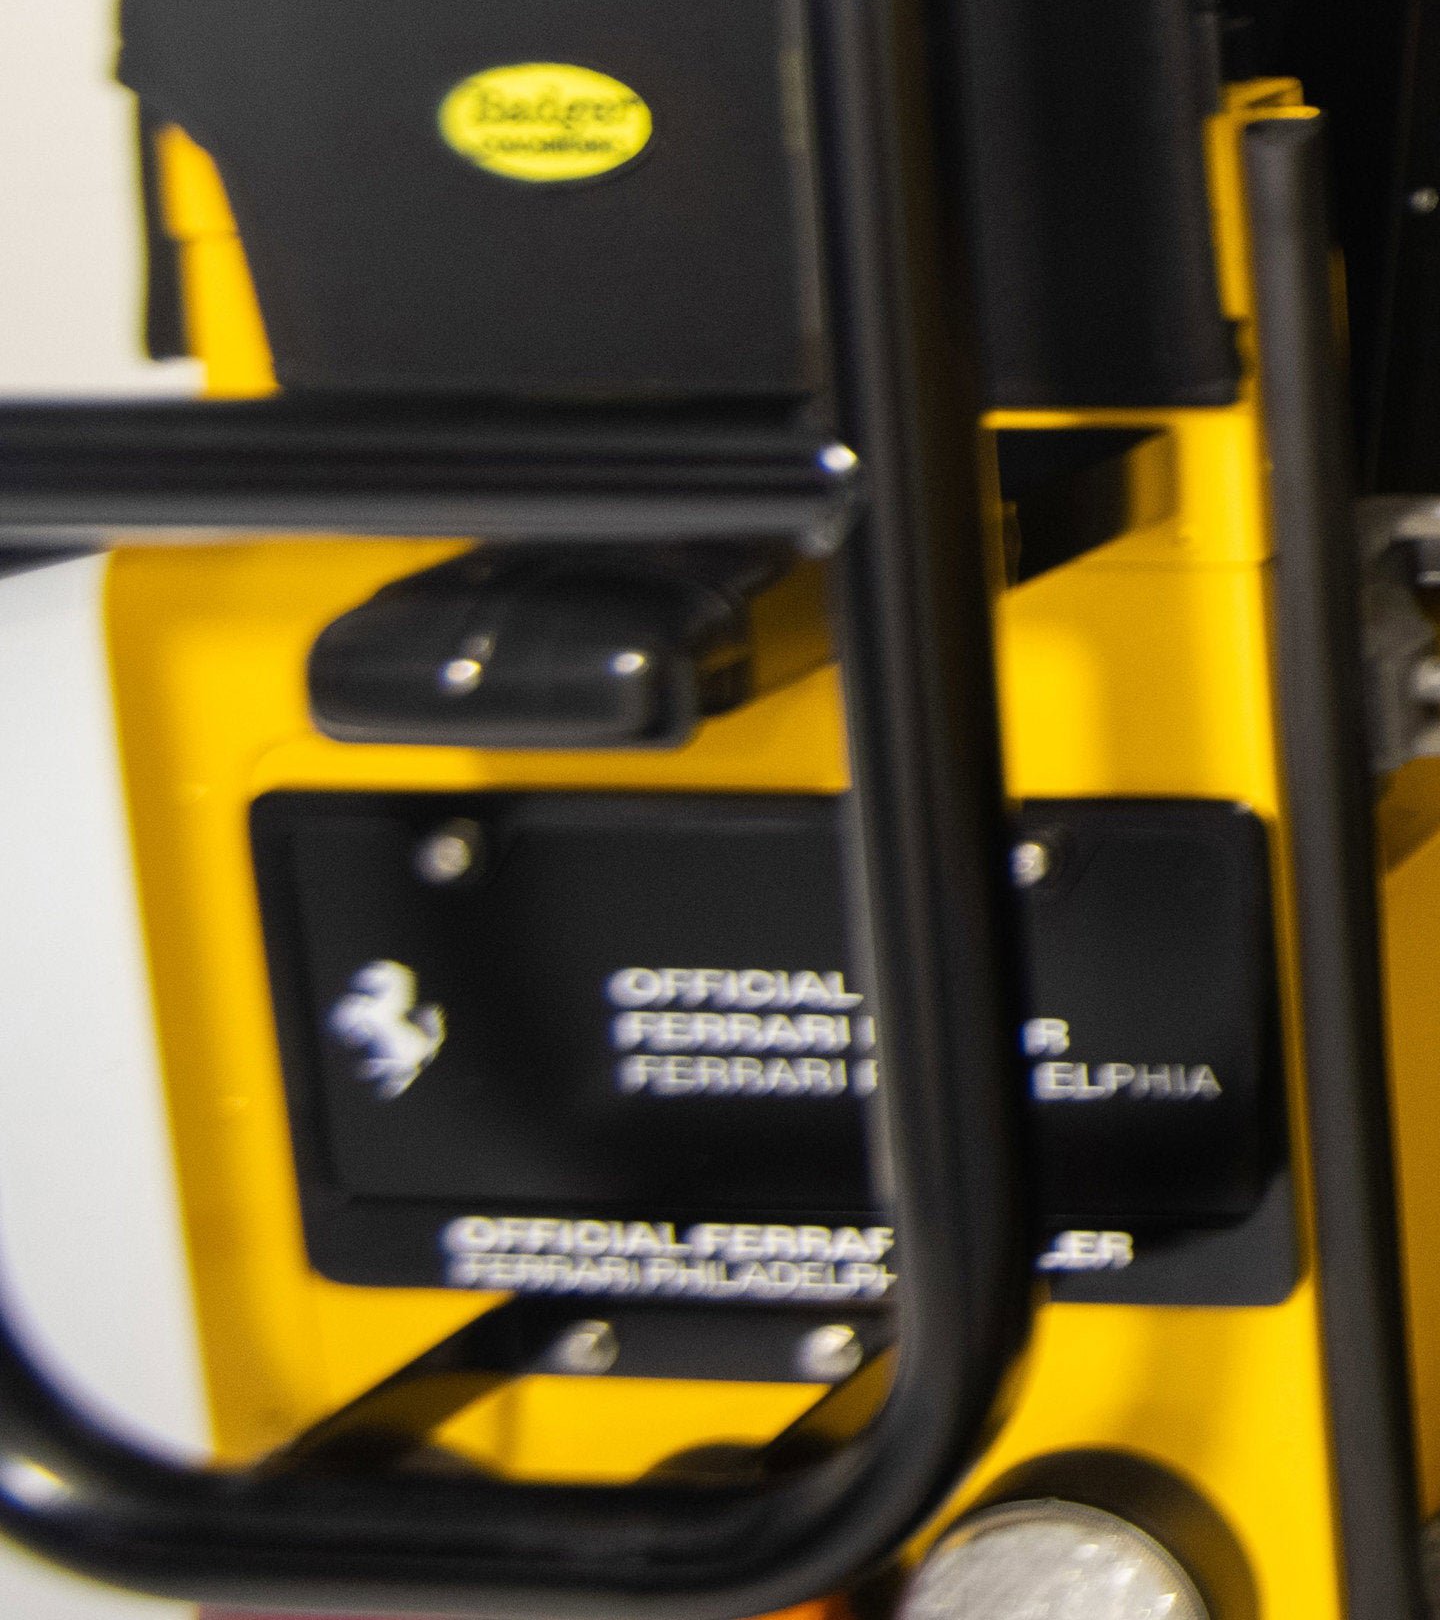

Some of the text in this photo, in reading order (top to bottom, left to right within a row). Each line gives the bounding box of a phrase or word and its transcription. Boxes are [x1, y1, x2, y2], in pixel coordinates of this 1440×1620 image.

[606, 967, 864, 1009] OFFICIAL
[611, 1011, 852, 1052] FERRARI
[615, 1054, 848, 1096] FERRARI
[442, 1216, 895, 1262] OFFICIAL FERRA
[448, 1253, 898, 1299] FERRARI PHILADELP
